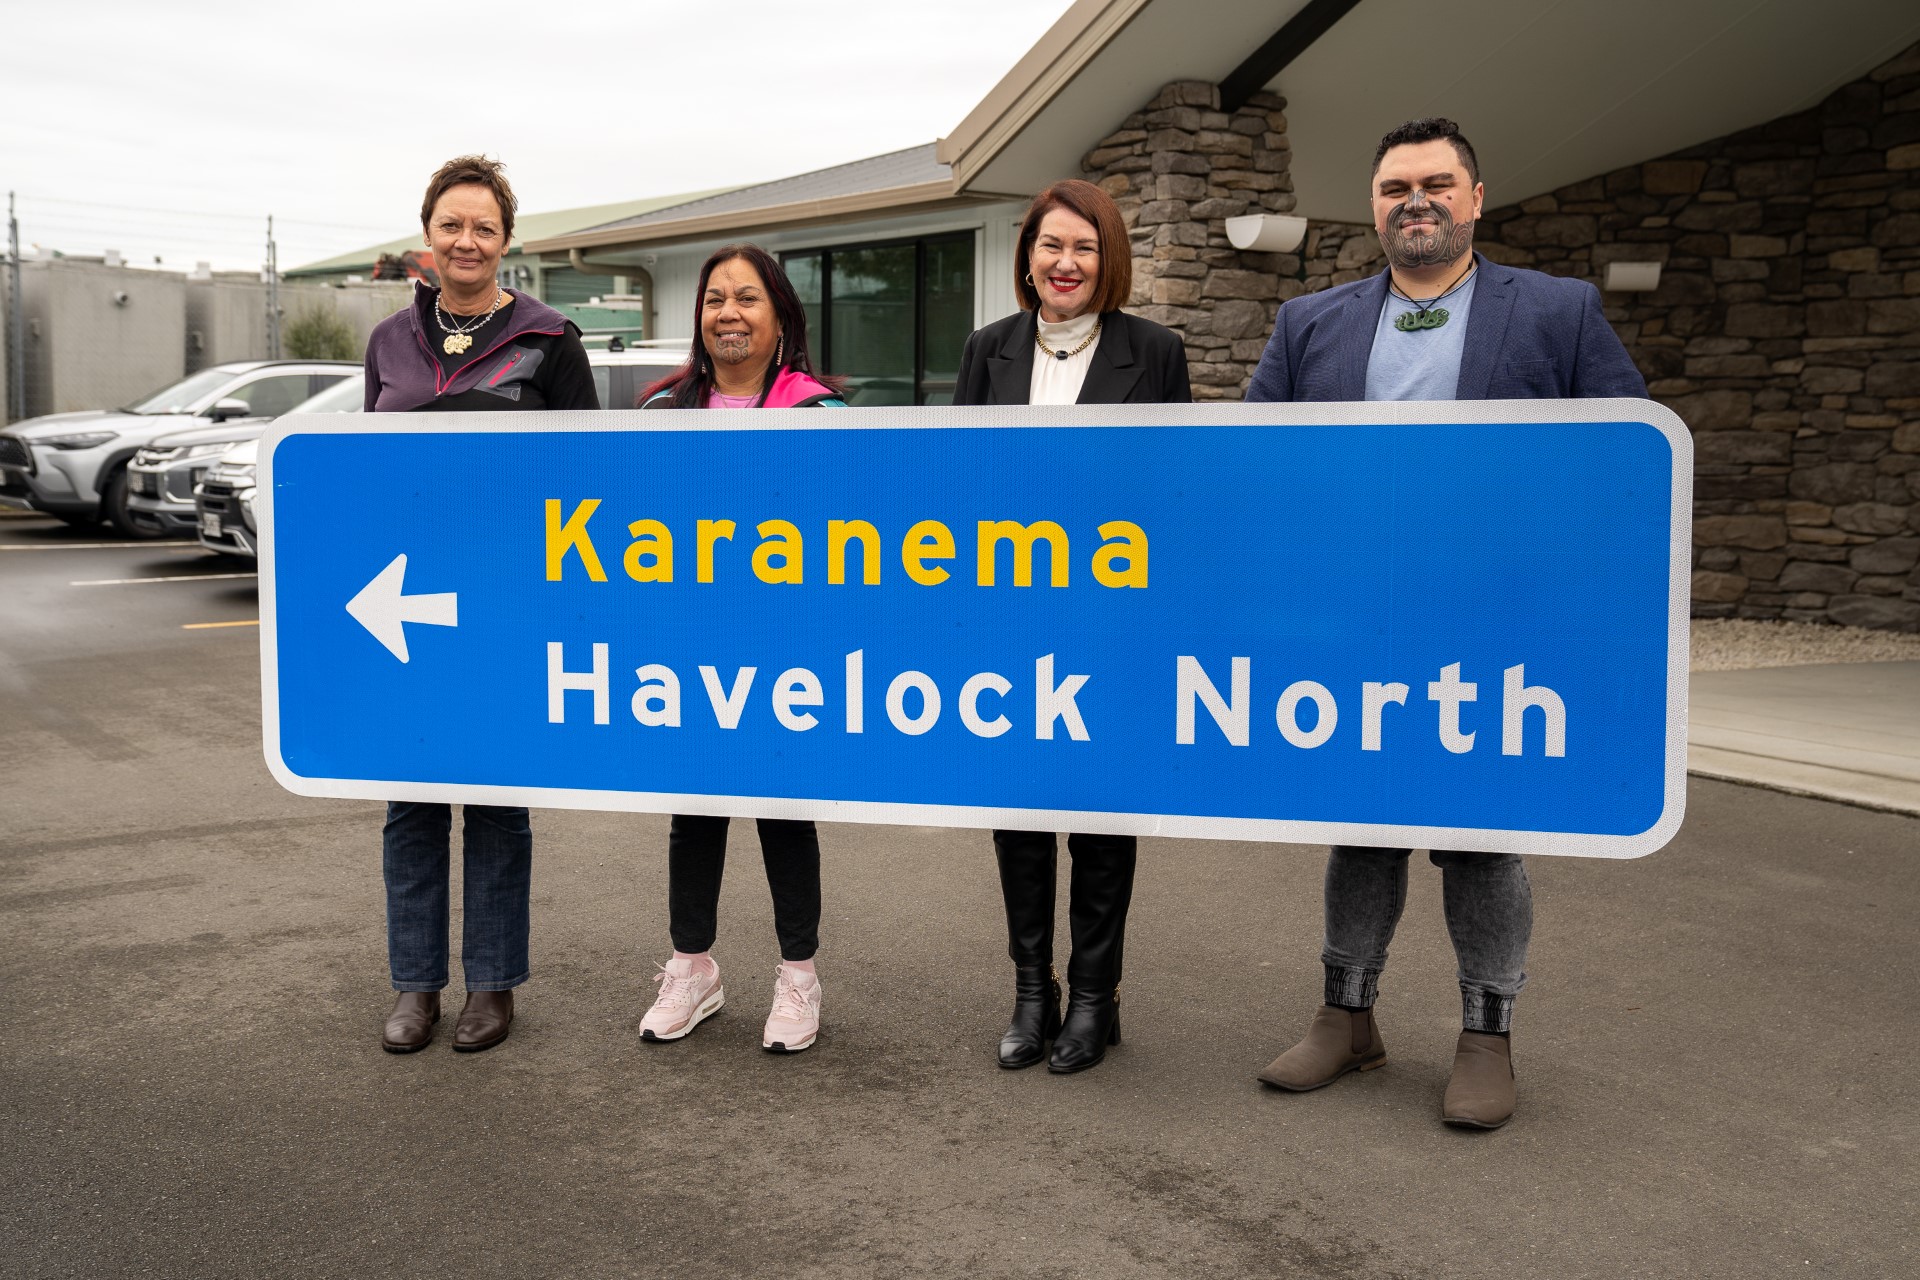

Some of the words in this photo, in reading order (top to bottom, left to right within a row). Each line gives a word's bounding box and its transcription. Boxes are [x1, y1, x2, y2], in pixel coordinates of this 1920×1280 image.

[545, 498, 1151, 589] Karanema
[546, 641, 1091, 742] Havelock
[1175, 654, 1568, 759] North
